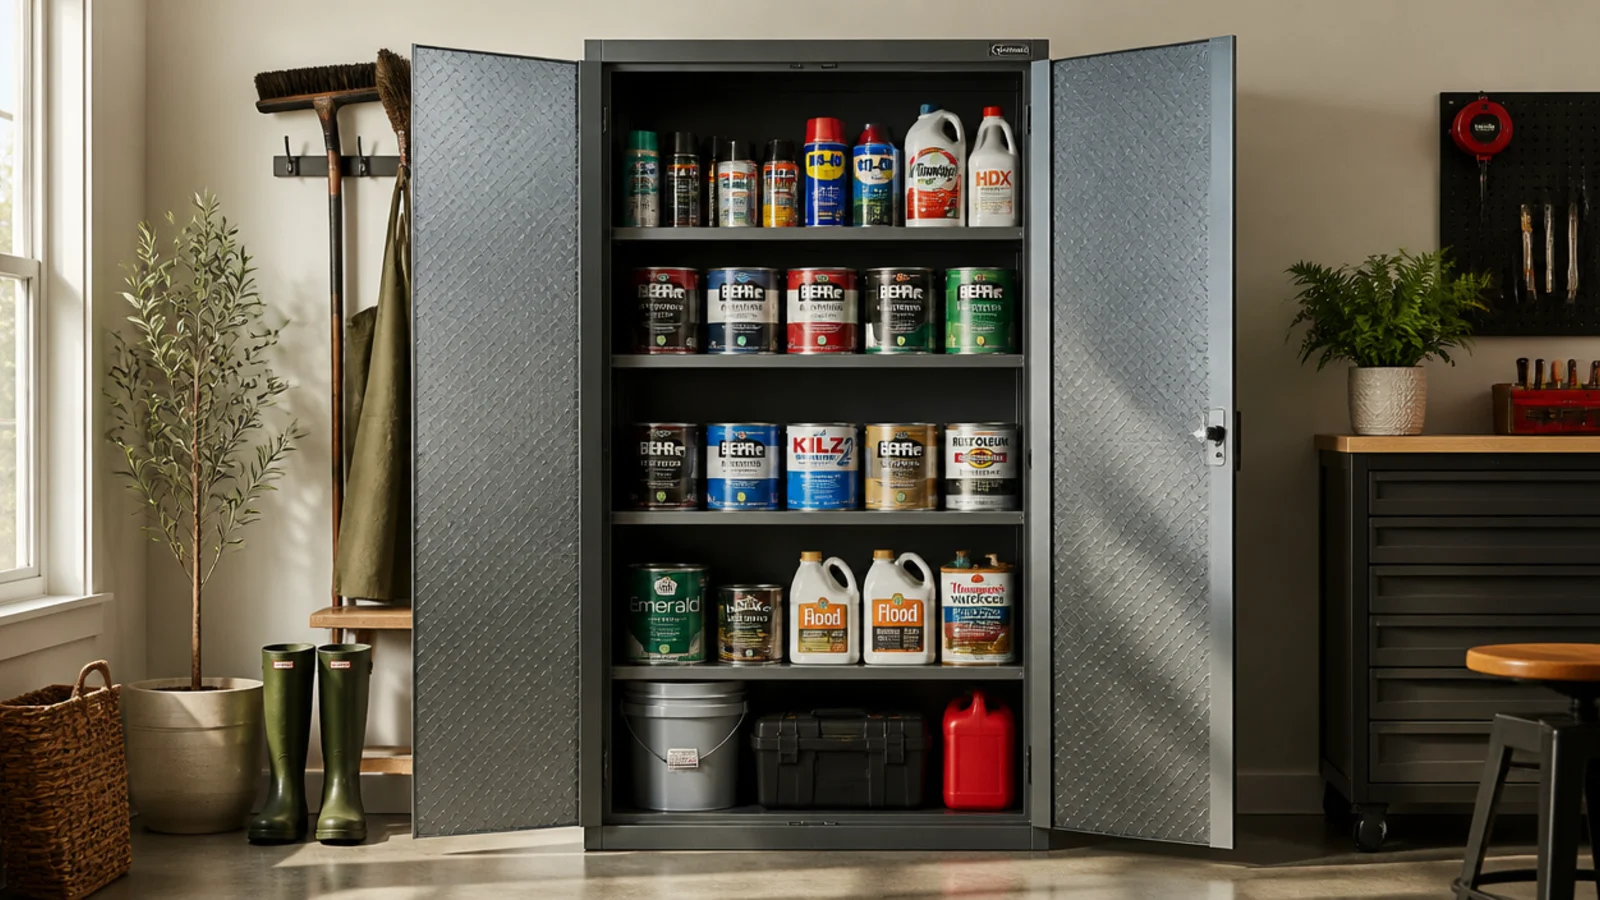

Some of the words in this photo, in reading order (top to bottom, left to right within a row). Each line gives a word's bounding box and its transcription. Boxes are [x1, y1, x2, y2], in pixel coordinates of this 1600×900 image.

[975, 170, 1012, 187] HDX
[793, 437, 845, 454] KILZ
[630, 596, 700, 613] Emerald
[878, 603, 918, 623] Flood
